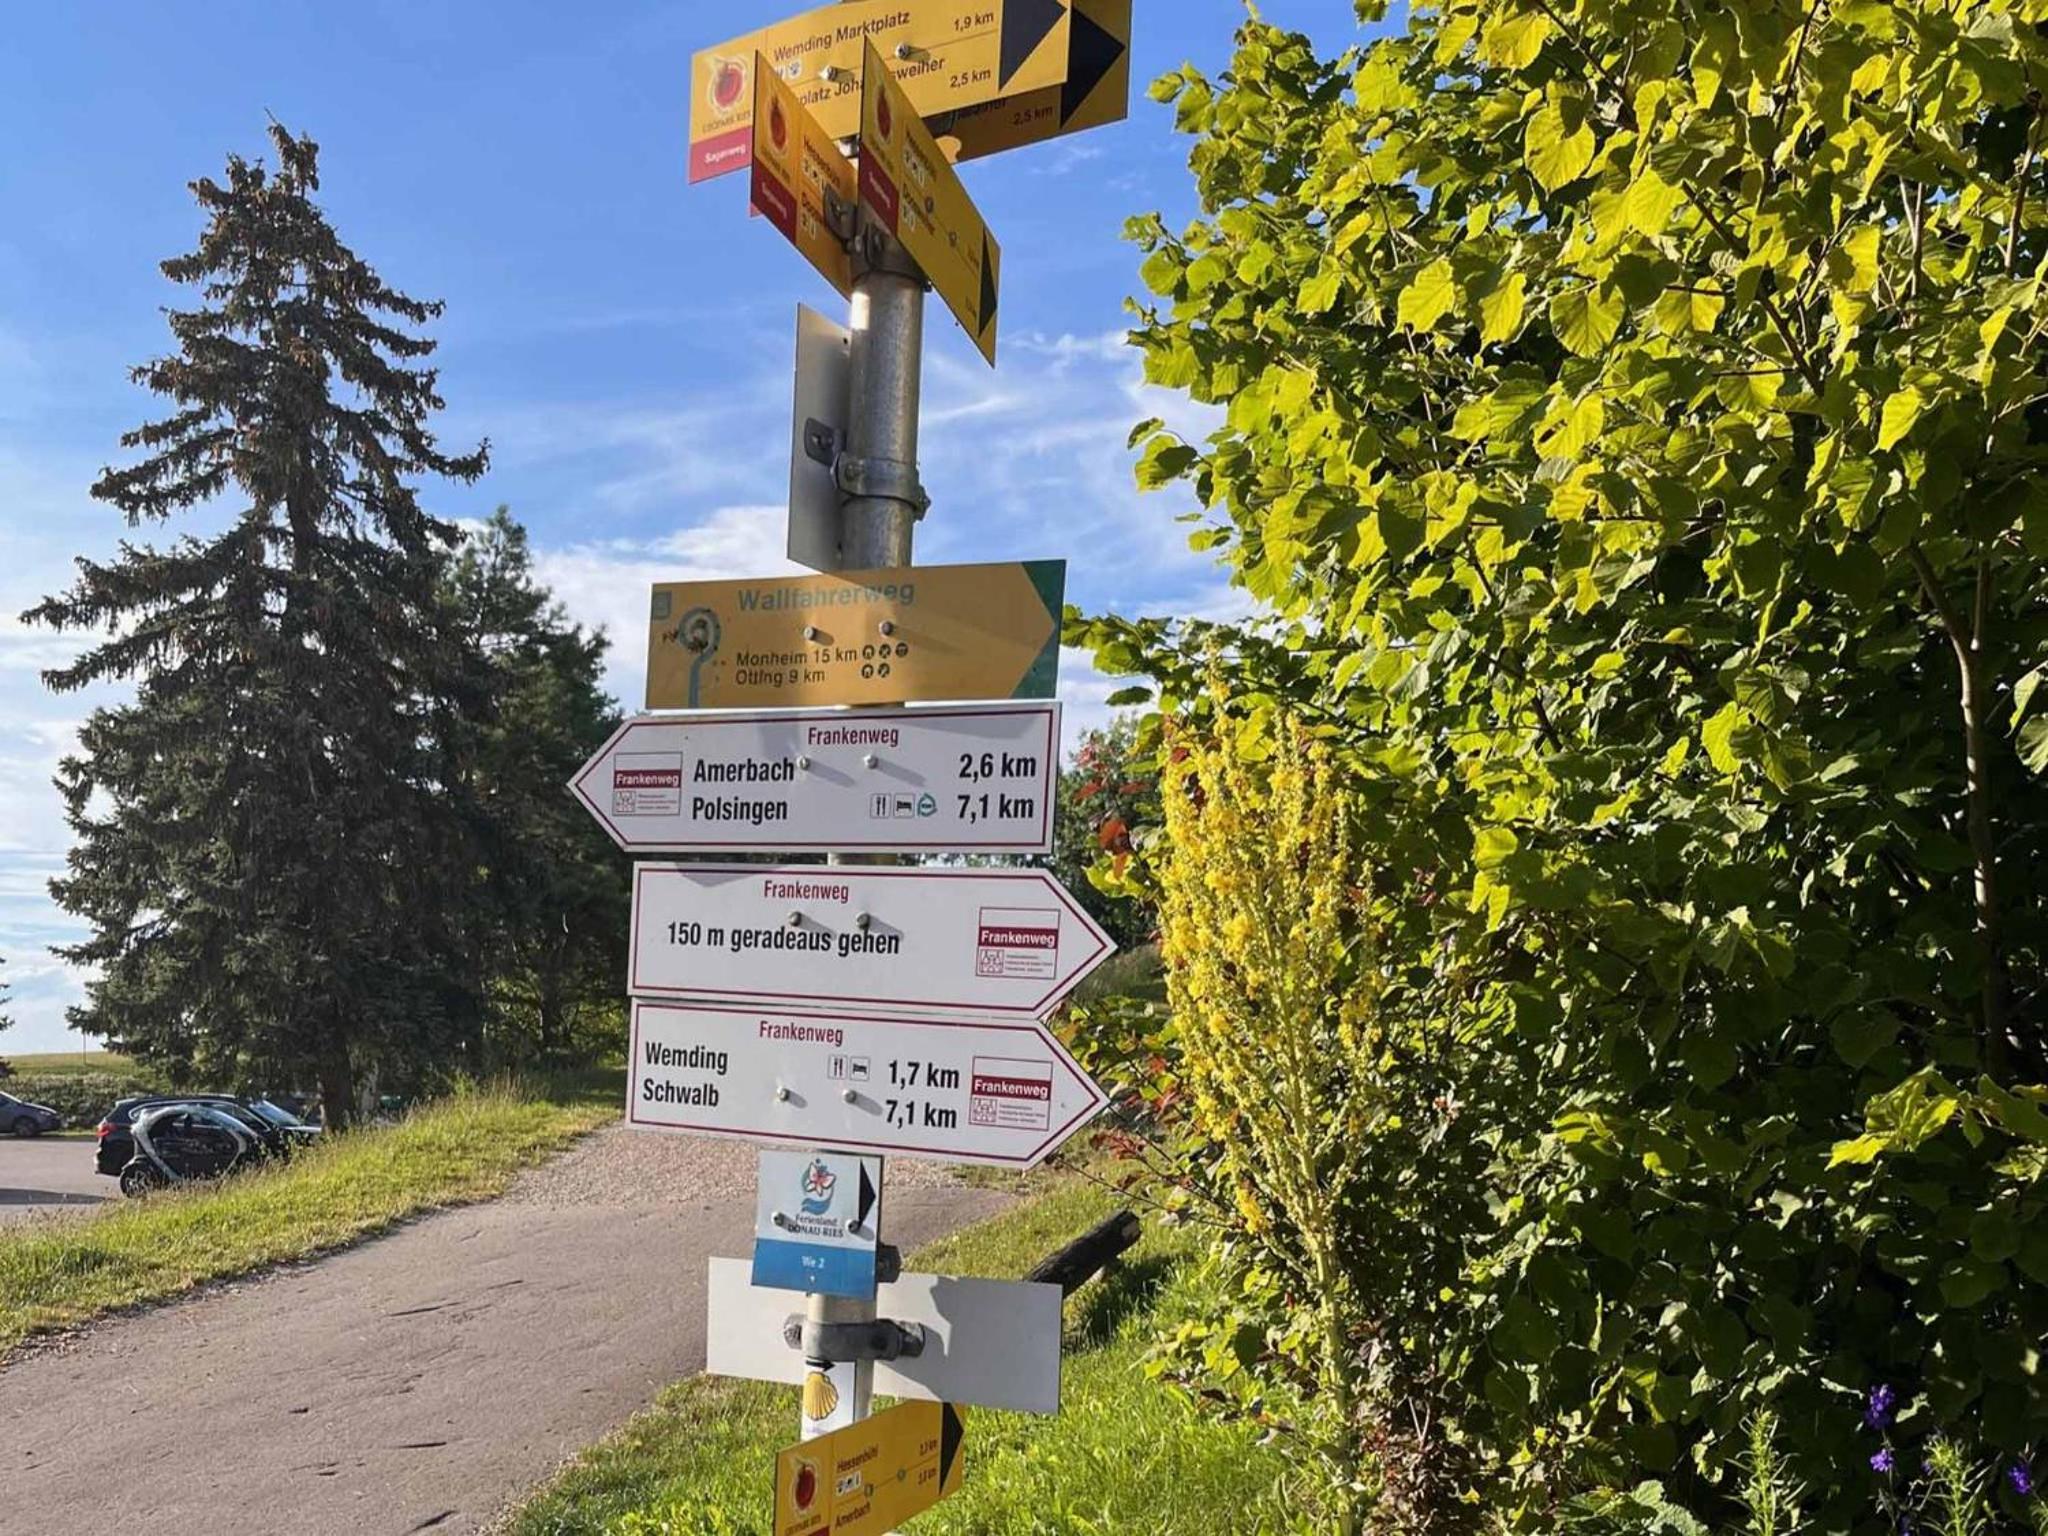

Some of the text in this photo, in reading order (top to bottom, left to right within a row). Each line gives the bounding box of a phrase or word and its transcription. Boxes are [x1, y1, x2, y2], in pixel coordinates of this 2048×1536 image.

[774, 11, 994, 61] Wemding Marktplatz 1,9 km
[950, 75, 969, 88] 2,5
[972, 68, 991, 82] km
[1034, 105, 1053, 119] km
[738, 582, 916, 611] Wallfahrerweg
[736, 647, 858, 667] Monheim 15 km
[736, 668, 825, 688] Otting 9 km
[808, 725, 899, 749] Frankenweg
[616, 773, 679, 787] Frankenweg
[693, 752, 1036, 783] Amerbach 2,6 km
[692, 796, 788, 826] Polsingen
[957, 795, 993, 821] 7,1
[998, 792, 1034, 818] km
[764, 880, 849, 905] Frankenweg
[667, 923, 900, 956] 150 m geradeaus gehen
[981, 930, 1056, 948] Frankenweg
[759, 1021, 843, 1046] Frankenweg
[645, 1042, 959, 1088] Wemding 1,7 km
[973, 1078, 1049, 1098] Frankenweg
[643, 1078, 957, 1130] Schwalb 7,1 km
